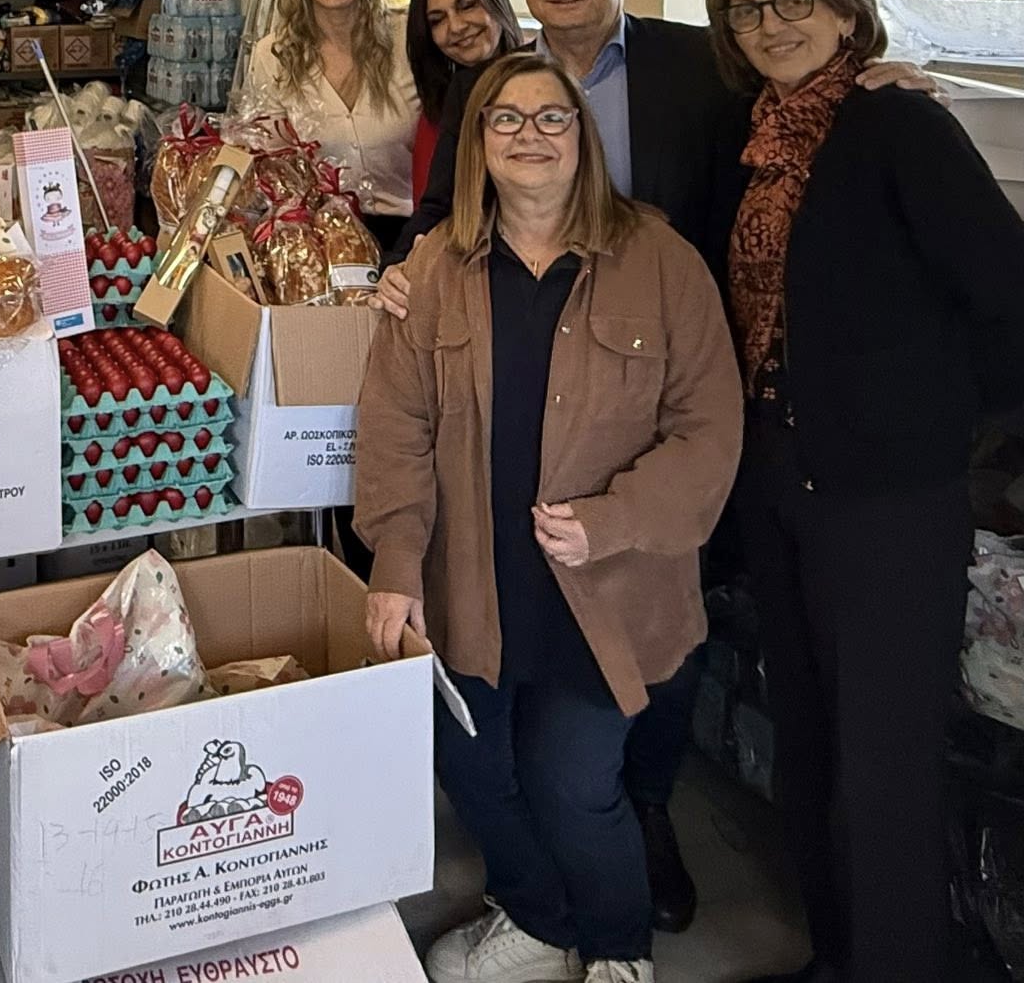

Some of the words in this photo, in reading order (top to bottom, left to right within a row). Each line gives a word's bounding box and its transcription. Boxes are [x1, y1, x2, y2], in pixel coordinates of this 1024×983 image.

[307, 454, 324, 466] ISO
[92, 756, 153, 814] 22000:2018
[98, 758, 122, 782] ISO
[163, 821, 290, 860] ΚΟΝΤΟΓΙΑΝΝΗ
[190, 813, 262, 840] ΑΥΓΑ
[132, 872, 191, 894] ΦΩΤΗΣ
[194, 866, 210, 880] Α.
[215, 839, 328, 875] ΚΟΝΤΟΓΙΑΝΝΗΣ
[154, 887, 211, 909] ΠΑΡΑΓΩΓΗ
[213, 886, 221, 895] &
[224, 874, 272, 892] ΕΜΠΟΡΙΑ
[164, 907, 182, 919] 210
[185, 895, 231, 914] 28.44.490
[239, 889, 260, 901] FAX:
[262, 884, 280, 895] 210
[169, 893, 294, 931] www.kontogiannis-eggs.gr
[176, 945, 300, 983] ΕΥΘΡΑΥΣΤΟ
